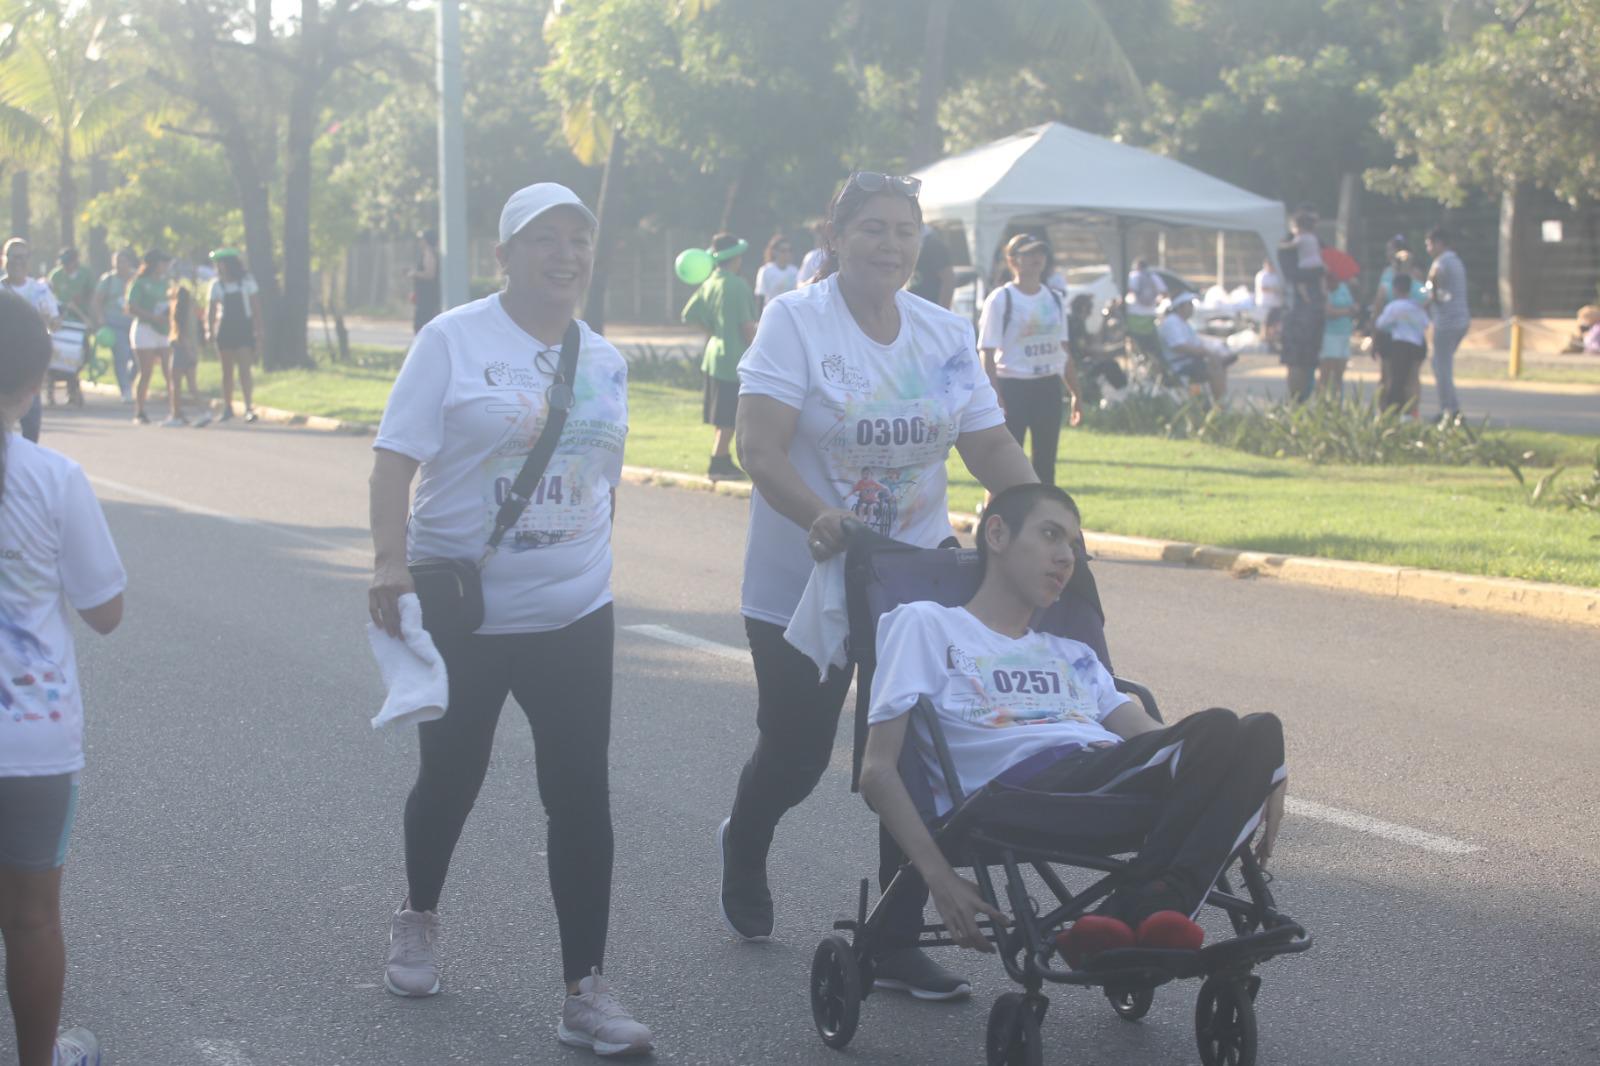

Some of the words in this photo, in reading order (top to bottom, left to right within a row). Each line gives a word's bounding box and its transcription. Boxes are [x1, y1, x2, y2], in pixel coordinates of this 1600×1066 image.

[856, 416, 926, 446] 0300
[494, 475, 564, 506] 074
[992, 669, 1061, 694] 0257
